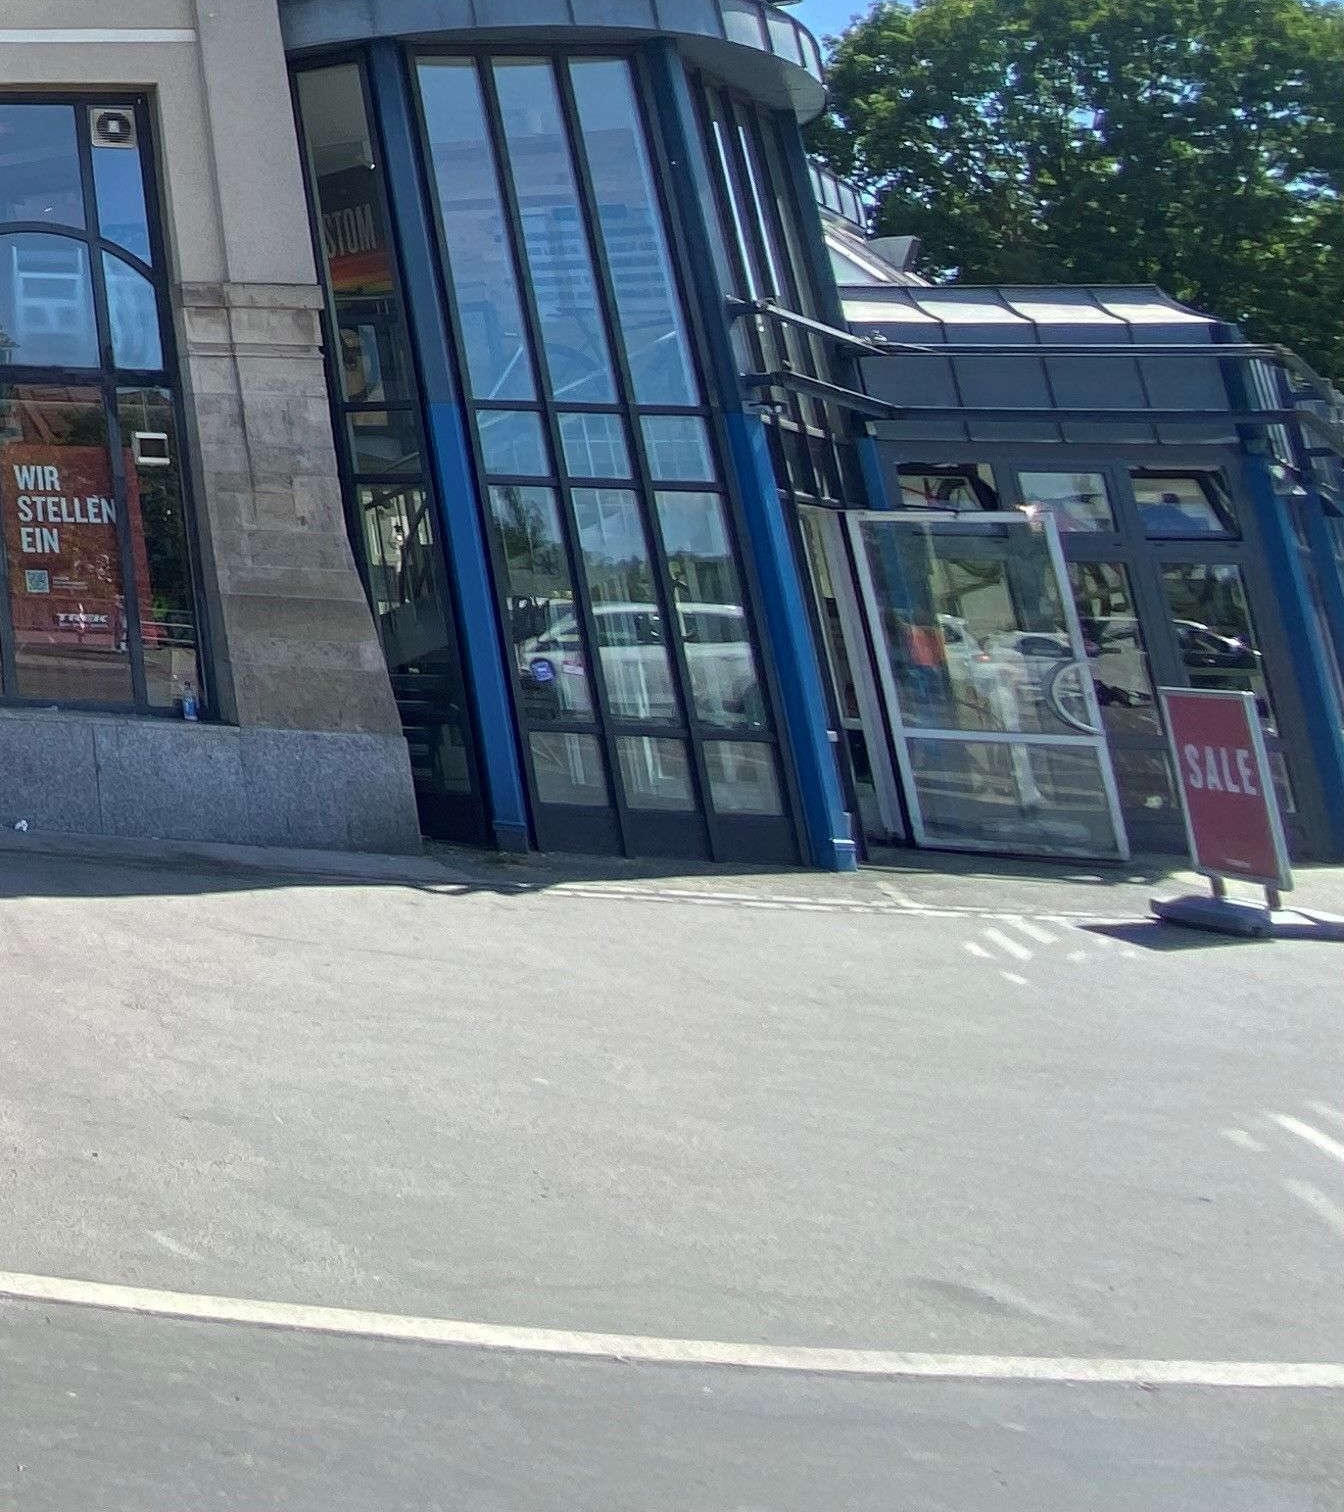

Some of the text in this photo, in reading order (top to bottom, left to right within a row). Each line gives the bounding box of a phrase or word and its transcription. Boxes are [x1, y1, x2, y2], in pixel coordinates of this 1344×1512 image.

[13, 464, 61, 491] WIR
[17, 495, 117, 524] STELLEN
[20, 527, 61, 554] EIN
[1184, 743, 1258, 796] SALE
